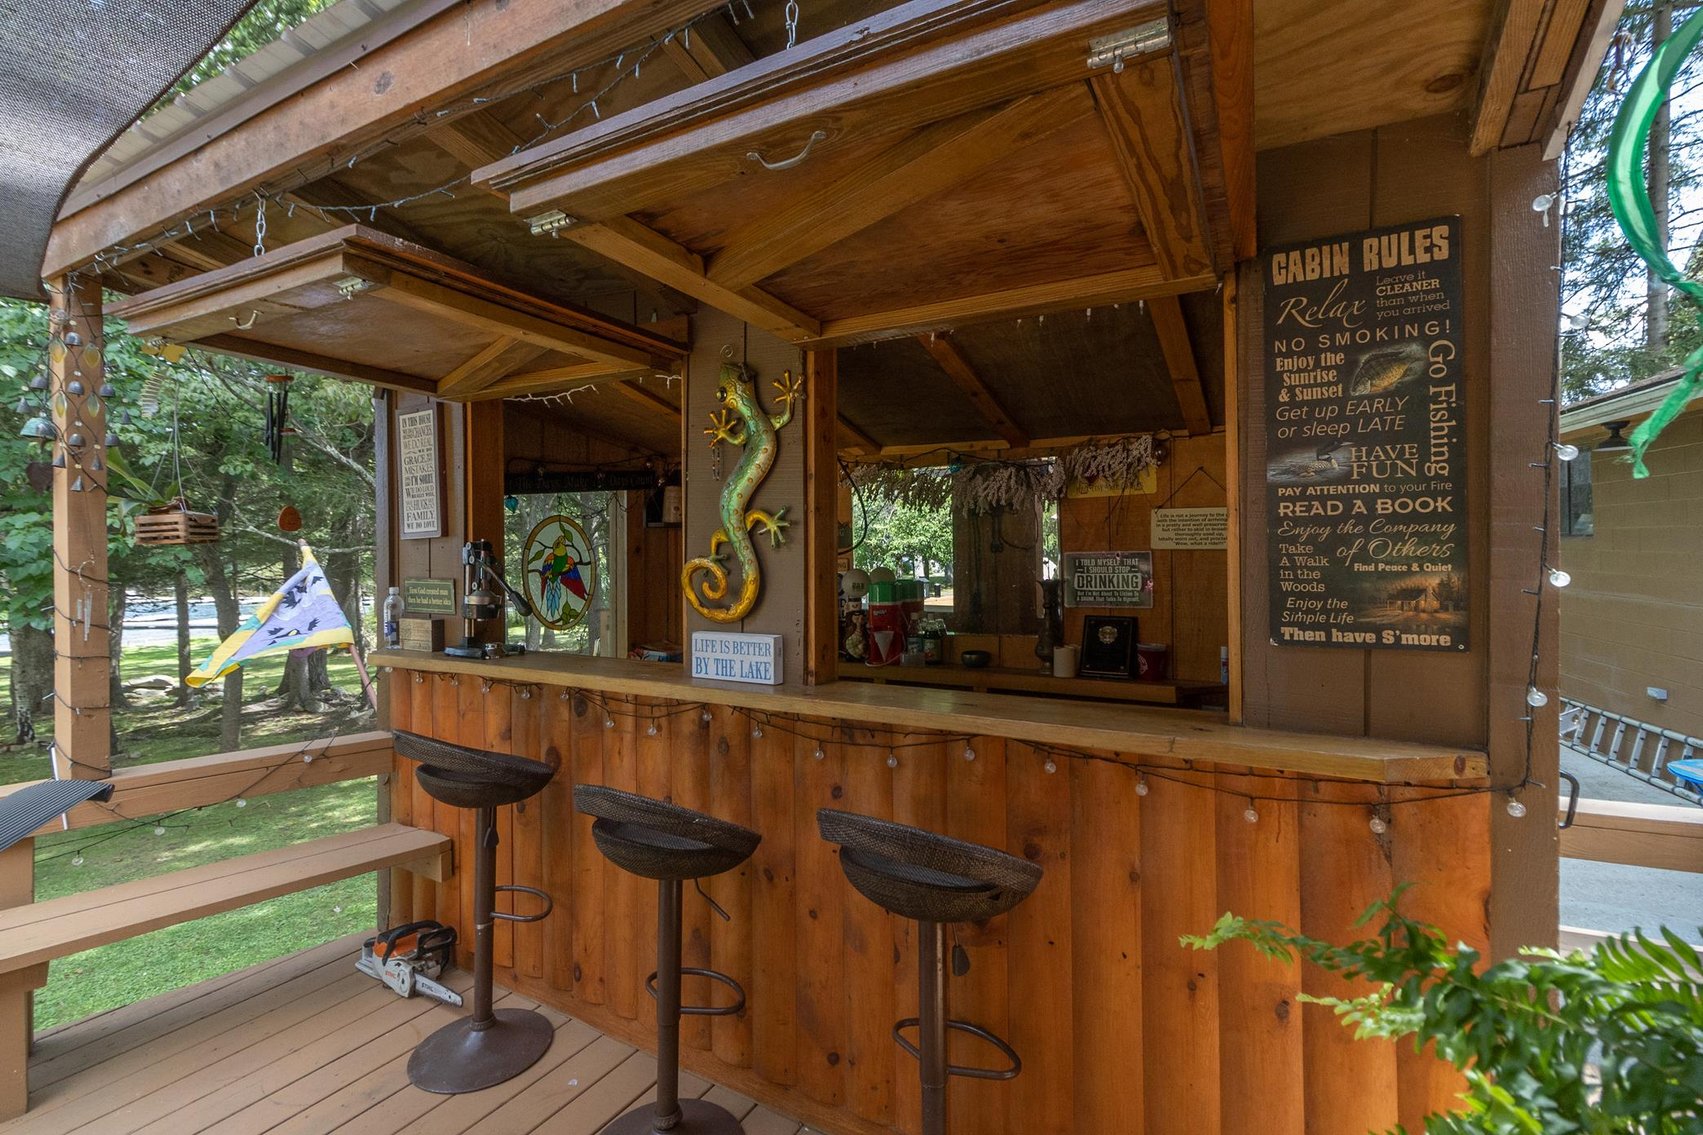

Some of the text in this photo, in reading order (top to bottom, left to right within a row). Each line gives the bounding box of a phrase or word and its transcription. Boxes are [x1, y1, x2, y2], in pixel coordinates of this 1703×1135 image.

[1272, 226, 1449, 286] CABIN RULES
[1376, 270, 1426, 286] Leave it
[1376, 279, 1440, 296] CLEANER
[1276, 278, 1367, 328] Relax
[1376, 290, 1444, 308] than when
[1376, 300, 1450, 320] you arrived
[1274, 319, 1450, 353] NO SMOKING!
[1276, 351, 1344, 372] Enjoy the
[1283, 368, 1337, 386] Sunrise
[1279, 383, 1343, 402] & Sunset
[1276, 396, 1409, 421] Get up EARLY
[1424, 339, 1456, 476] Go Fishing
[1277, 416, 1406, 439] or sleep LATE
[1350, 444, 1418, 462] HAVE
[1351, 459, 1418, 480] FUN
[1278, 481, 1452, 496] PAY ATTENTION to your Fire
[1278, 496, 1453, 517] READ A BOOK
[407, 511, 434, 521] FAMILY
[1277, 518, 1456, 542] Enjoy the Company
[1279, 544, 1313, 554] Take
[1336, 538, 1454, 566] of Others
[1280, 556, 1329, 566] A Walk
[1354, 563, 1452, 572] Find Peace & Quiet
[1077, 575, 1139, 589] DRINKING
[1280, 569, 1321, 579] in the
[1280, 582, 1325, 592] Woods
[1286, 597, 1348, 610] Enjoy the
[1282, 611, 1354, 624] Simple Life
[1280, 627, 1451, 646] Then have S'more
[695, 639, 771, 657] LIFE IS BETTER
[695, 656, 771, 680] BY THE LAKE
